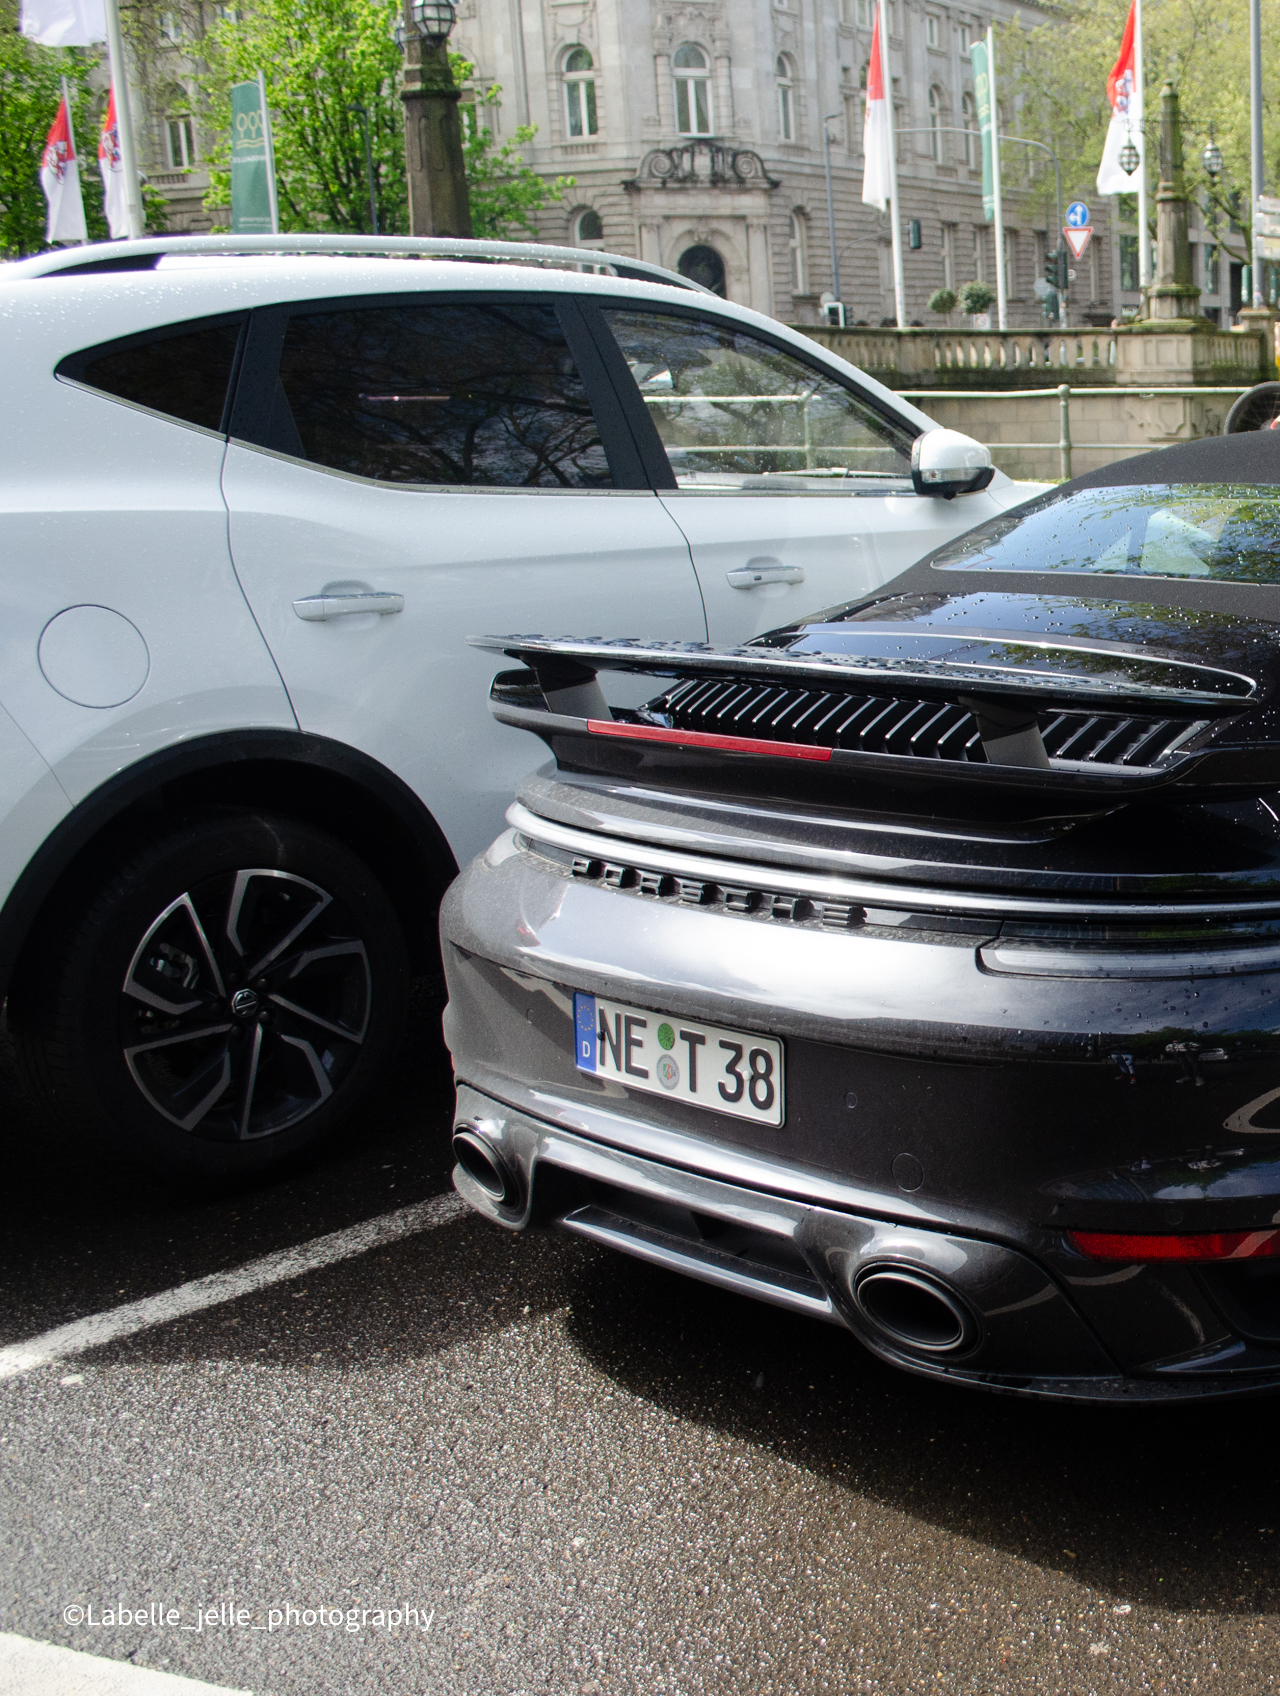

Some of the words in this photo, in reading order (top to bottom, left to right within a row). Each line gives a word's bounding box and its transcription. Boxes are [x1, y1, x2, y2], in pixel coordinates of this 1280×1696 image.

[571, 857, 854, 927] PORSCHE
[582, 1041, 591, 1058] D
[598, 1006, 649, 1079] NE
[679, 1027, 706, 1093] T
[717, 1037, 775, 1110] 38
